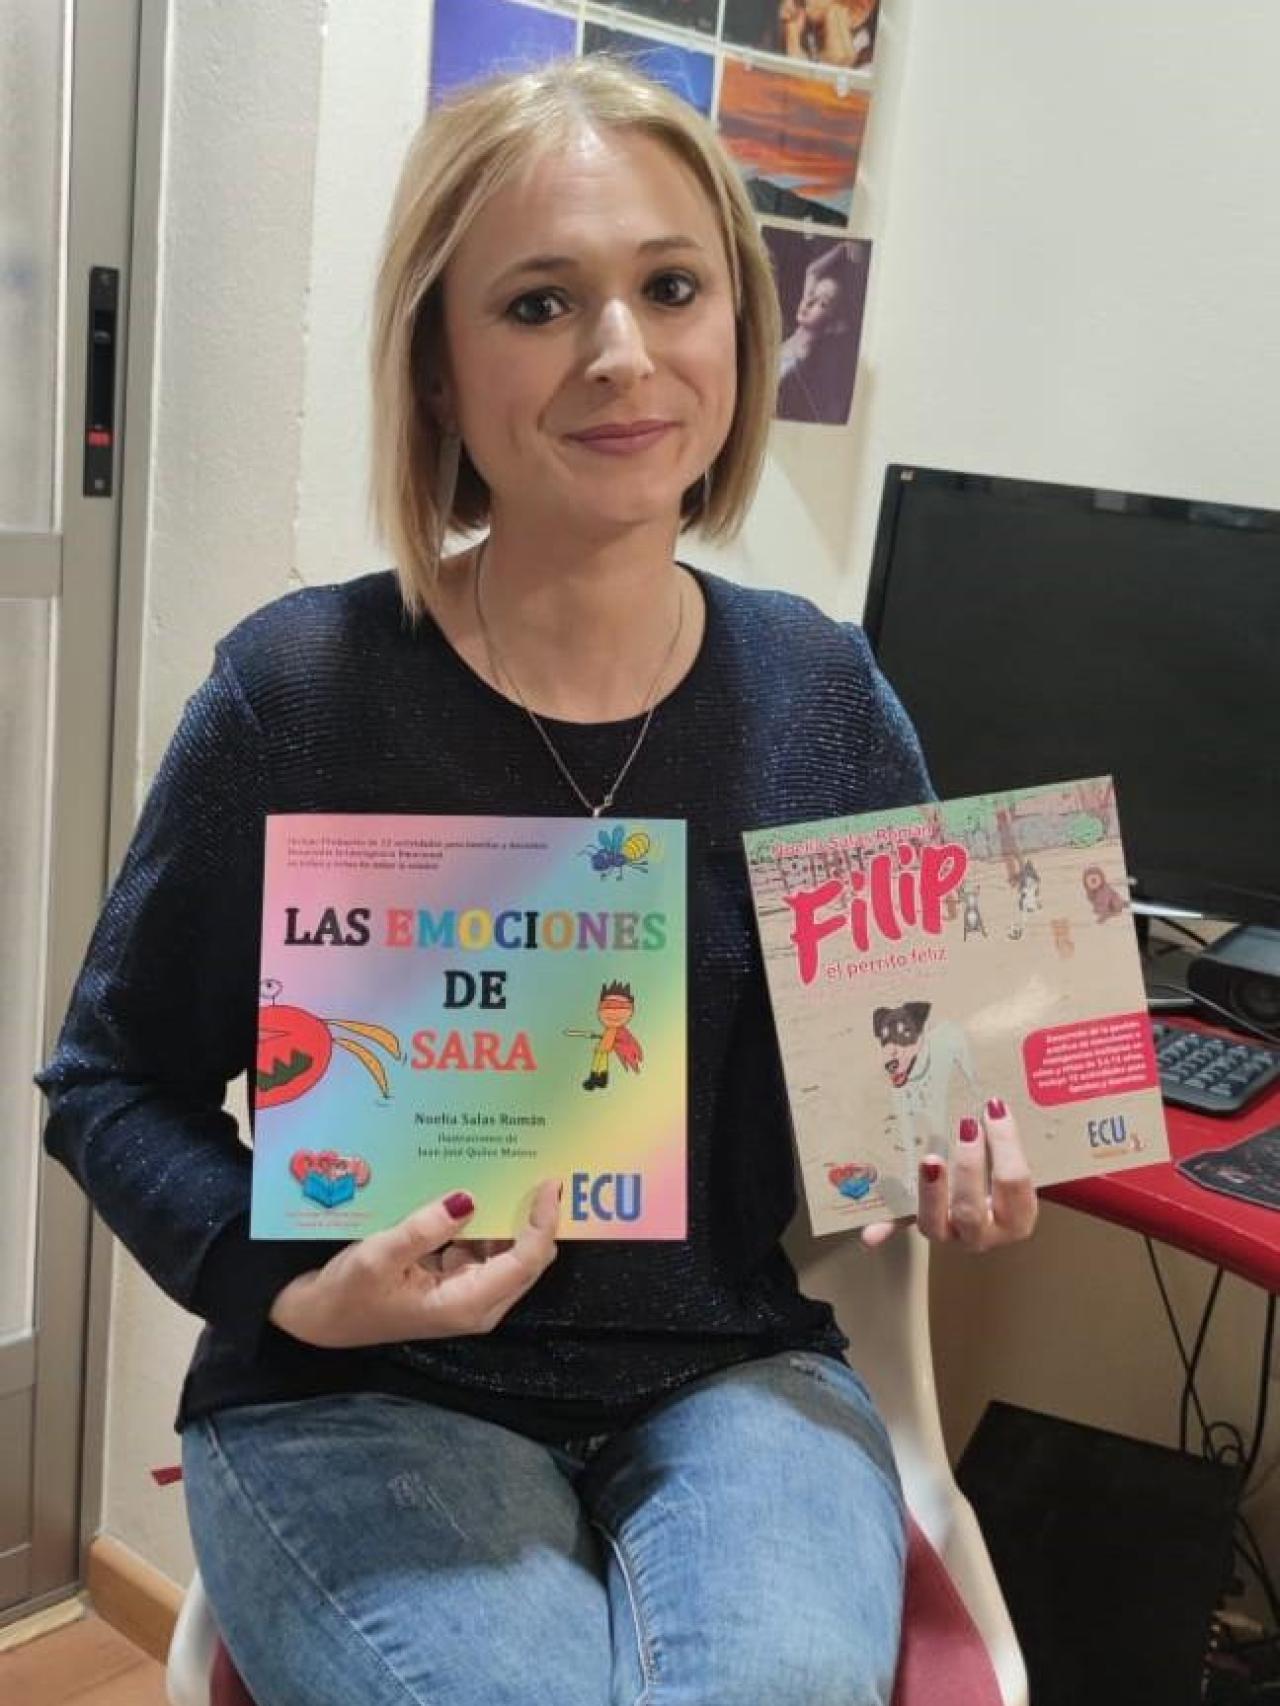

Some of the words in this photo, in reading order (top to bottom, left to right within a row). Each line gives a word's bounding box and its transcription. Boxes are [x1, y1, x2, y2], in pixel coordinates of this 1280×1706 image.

[284, 907, 371, 946] LAS
[385, 909, 667, 951] EMOCIONES
[826, 962, 842, 979] el
[847, 952, 906, 978] perrito
[909, 945, 947, 965] feliz
[442, 970, 507, 1010] DE
[410, 1030, 538, 1072] SARA
[414, 1111, 457, 1125] Noelia
[461, 1111, 496, 1125] Salas
[499, 1111, 546, 1126] Román
[1087, 1115, 1126, 1147] ECU
[572, 1172, 642, 1222] ECU
